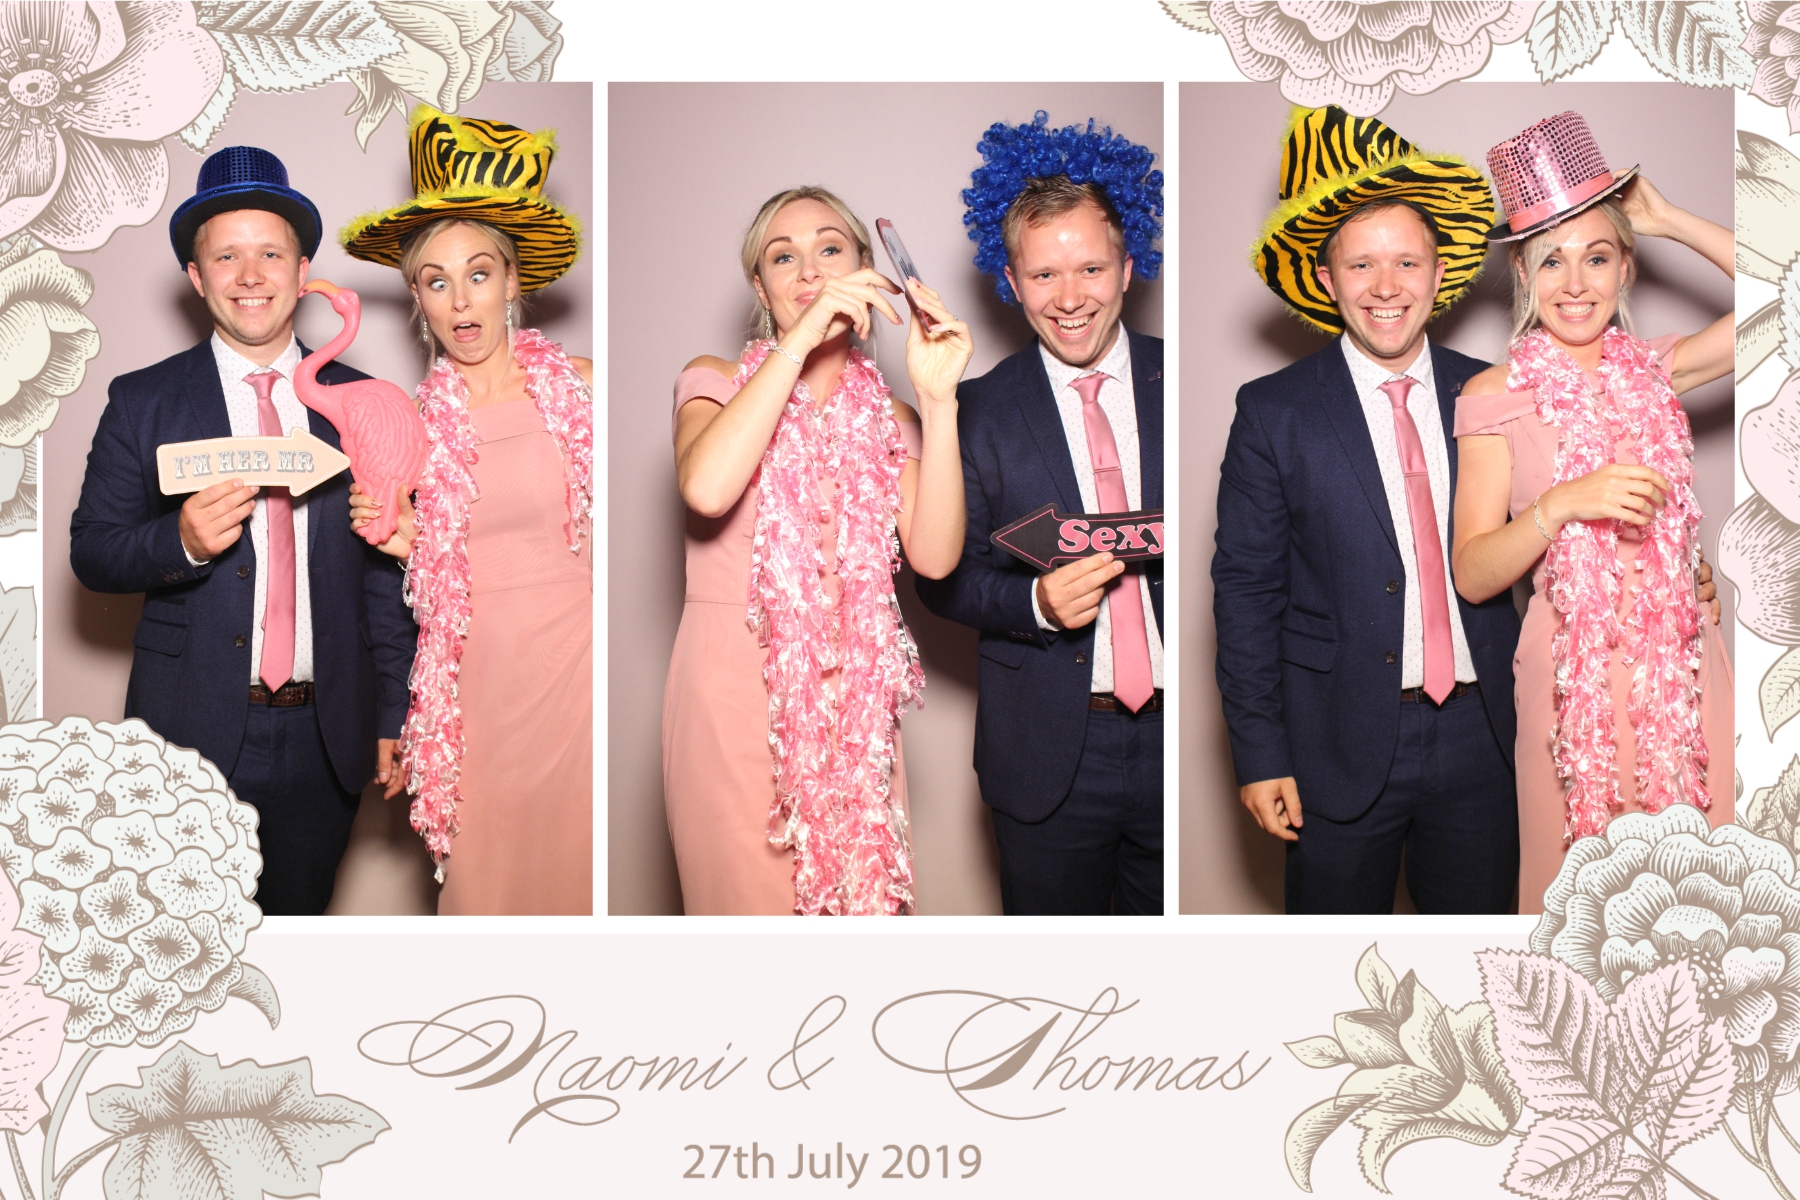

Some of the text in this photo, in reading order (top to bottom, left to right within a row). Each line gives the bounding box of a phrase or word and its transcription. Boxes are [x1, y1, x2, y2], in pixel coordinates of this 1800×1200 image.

[173, 450, 316, 479] I'M HER MR
